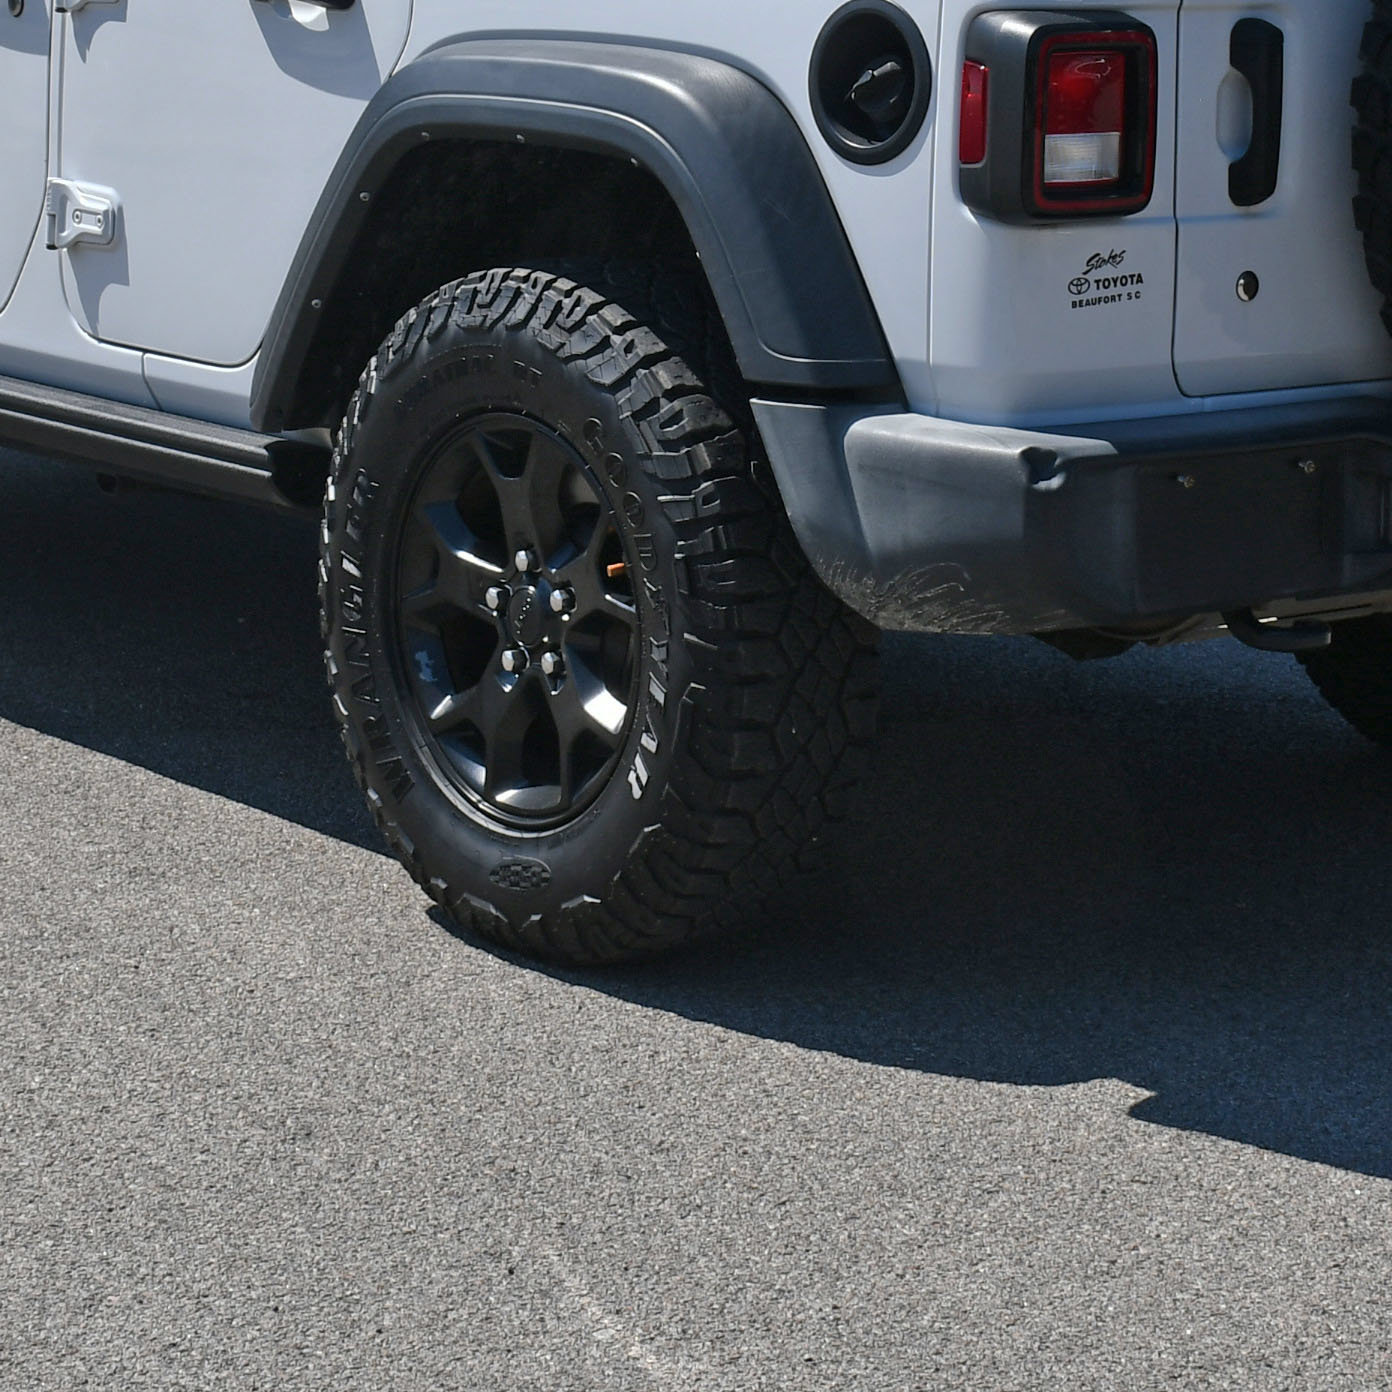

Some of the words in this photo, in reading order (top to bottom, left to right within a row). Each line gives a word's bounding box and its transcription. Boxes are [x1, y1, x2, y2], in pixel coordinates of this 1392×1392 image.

[1082, 248, 1127, 275] Stokes
[1094, 273, 1144, 291] TOYOTA
[1071, 293, 1123, 309] BEAUFORT
[583, 418, 672, 801] GOODYEAR
